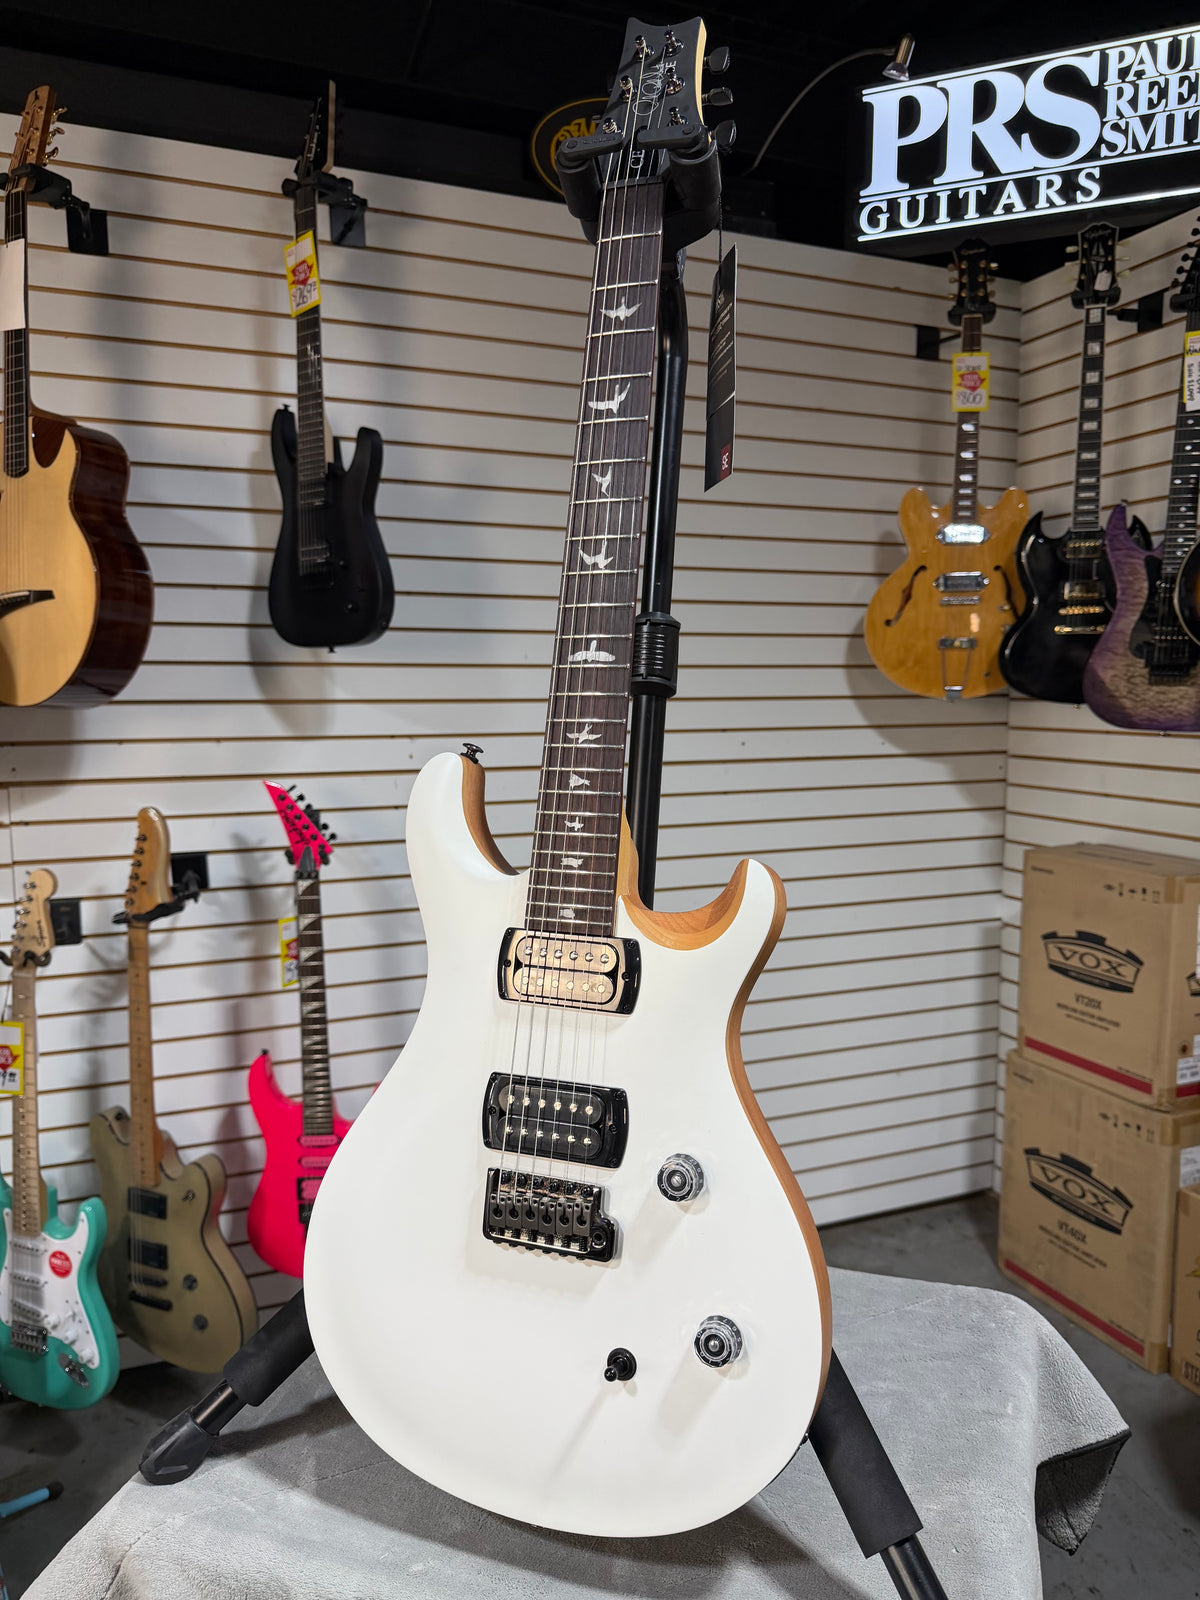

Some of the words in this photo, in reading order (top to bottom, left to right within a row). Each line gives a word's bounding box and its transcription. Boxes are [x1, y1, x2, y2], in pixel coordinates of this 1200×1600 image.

[1103, 70, 1200, 121] REE
[860, 51, 1100, 197] PRS
[859, 166, 1100, 235] GUITARS
[1054, 945, 1129, 978] VOX
[1038, 1164, 1117, 1218] VOX
